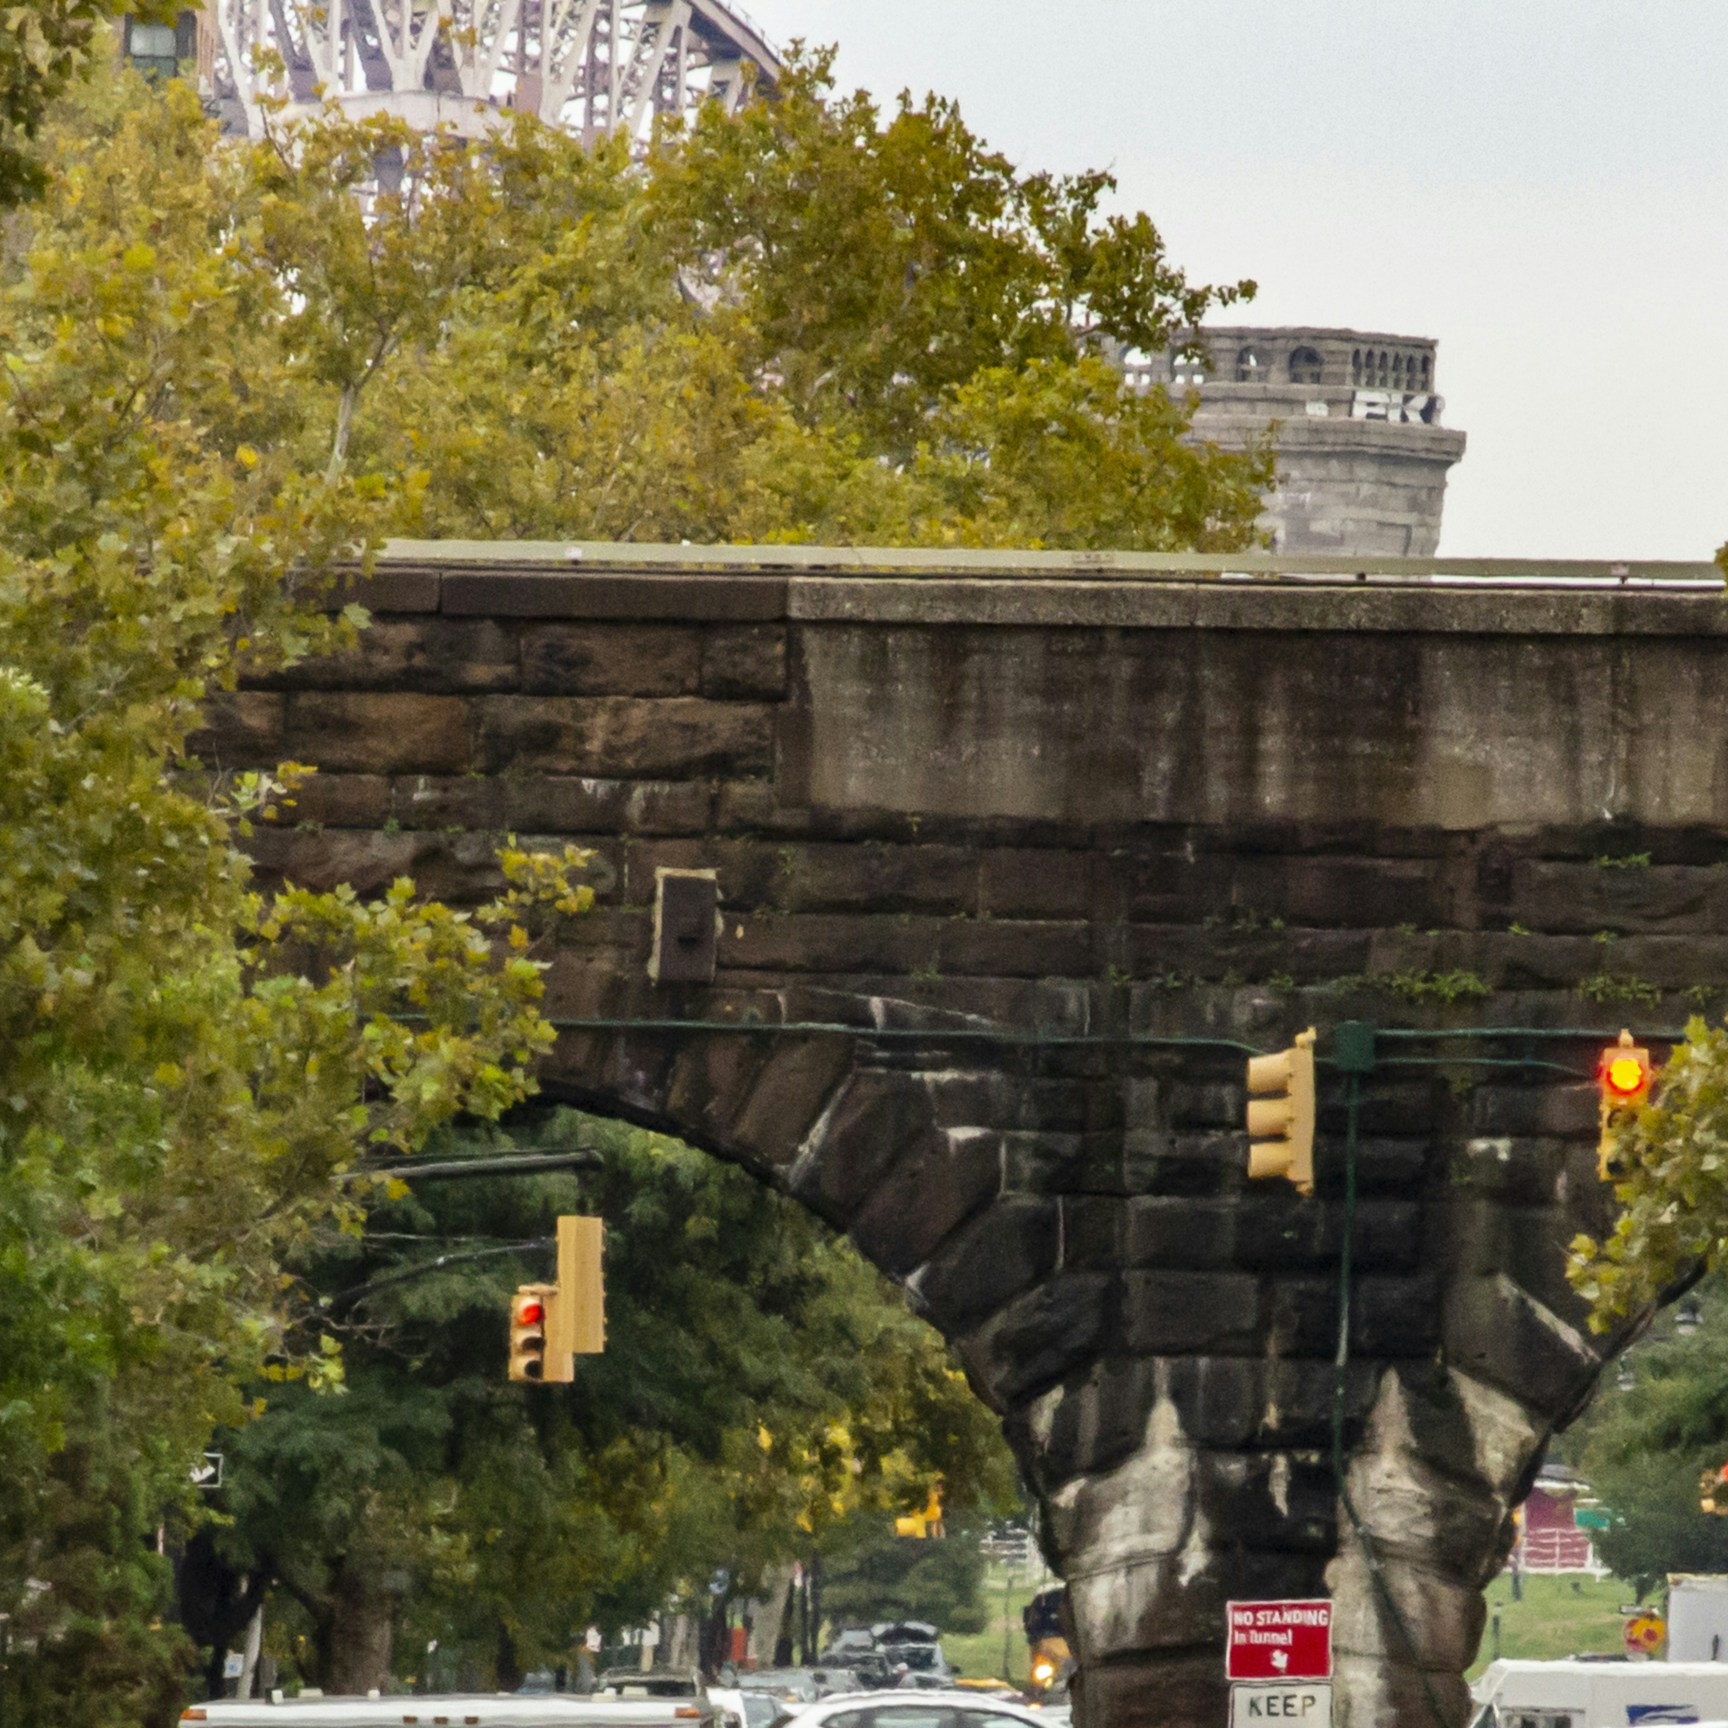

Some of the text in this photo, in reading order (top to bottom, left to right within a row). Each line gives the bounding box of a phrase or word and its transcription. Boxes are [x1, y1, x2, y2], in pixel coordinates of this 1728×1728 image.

[1233, 1609, 1329, 1627] NO STANDING
[1234, 1628, 1293, 1645] In Tunnel
[1248, 1694, 1316, 1718] KEEP
